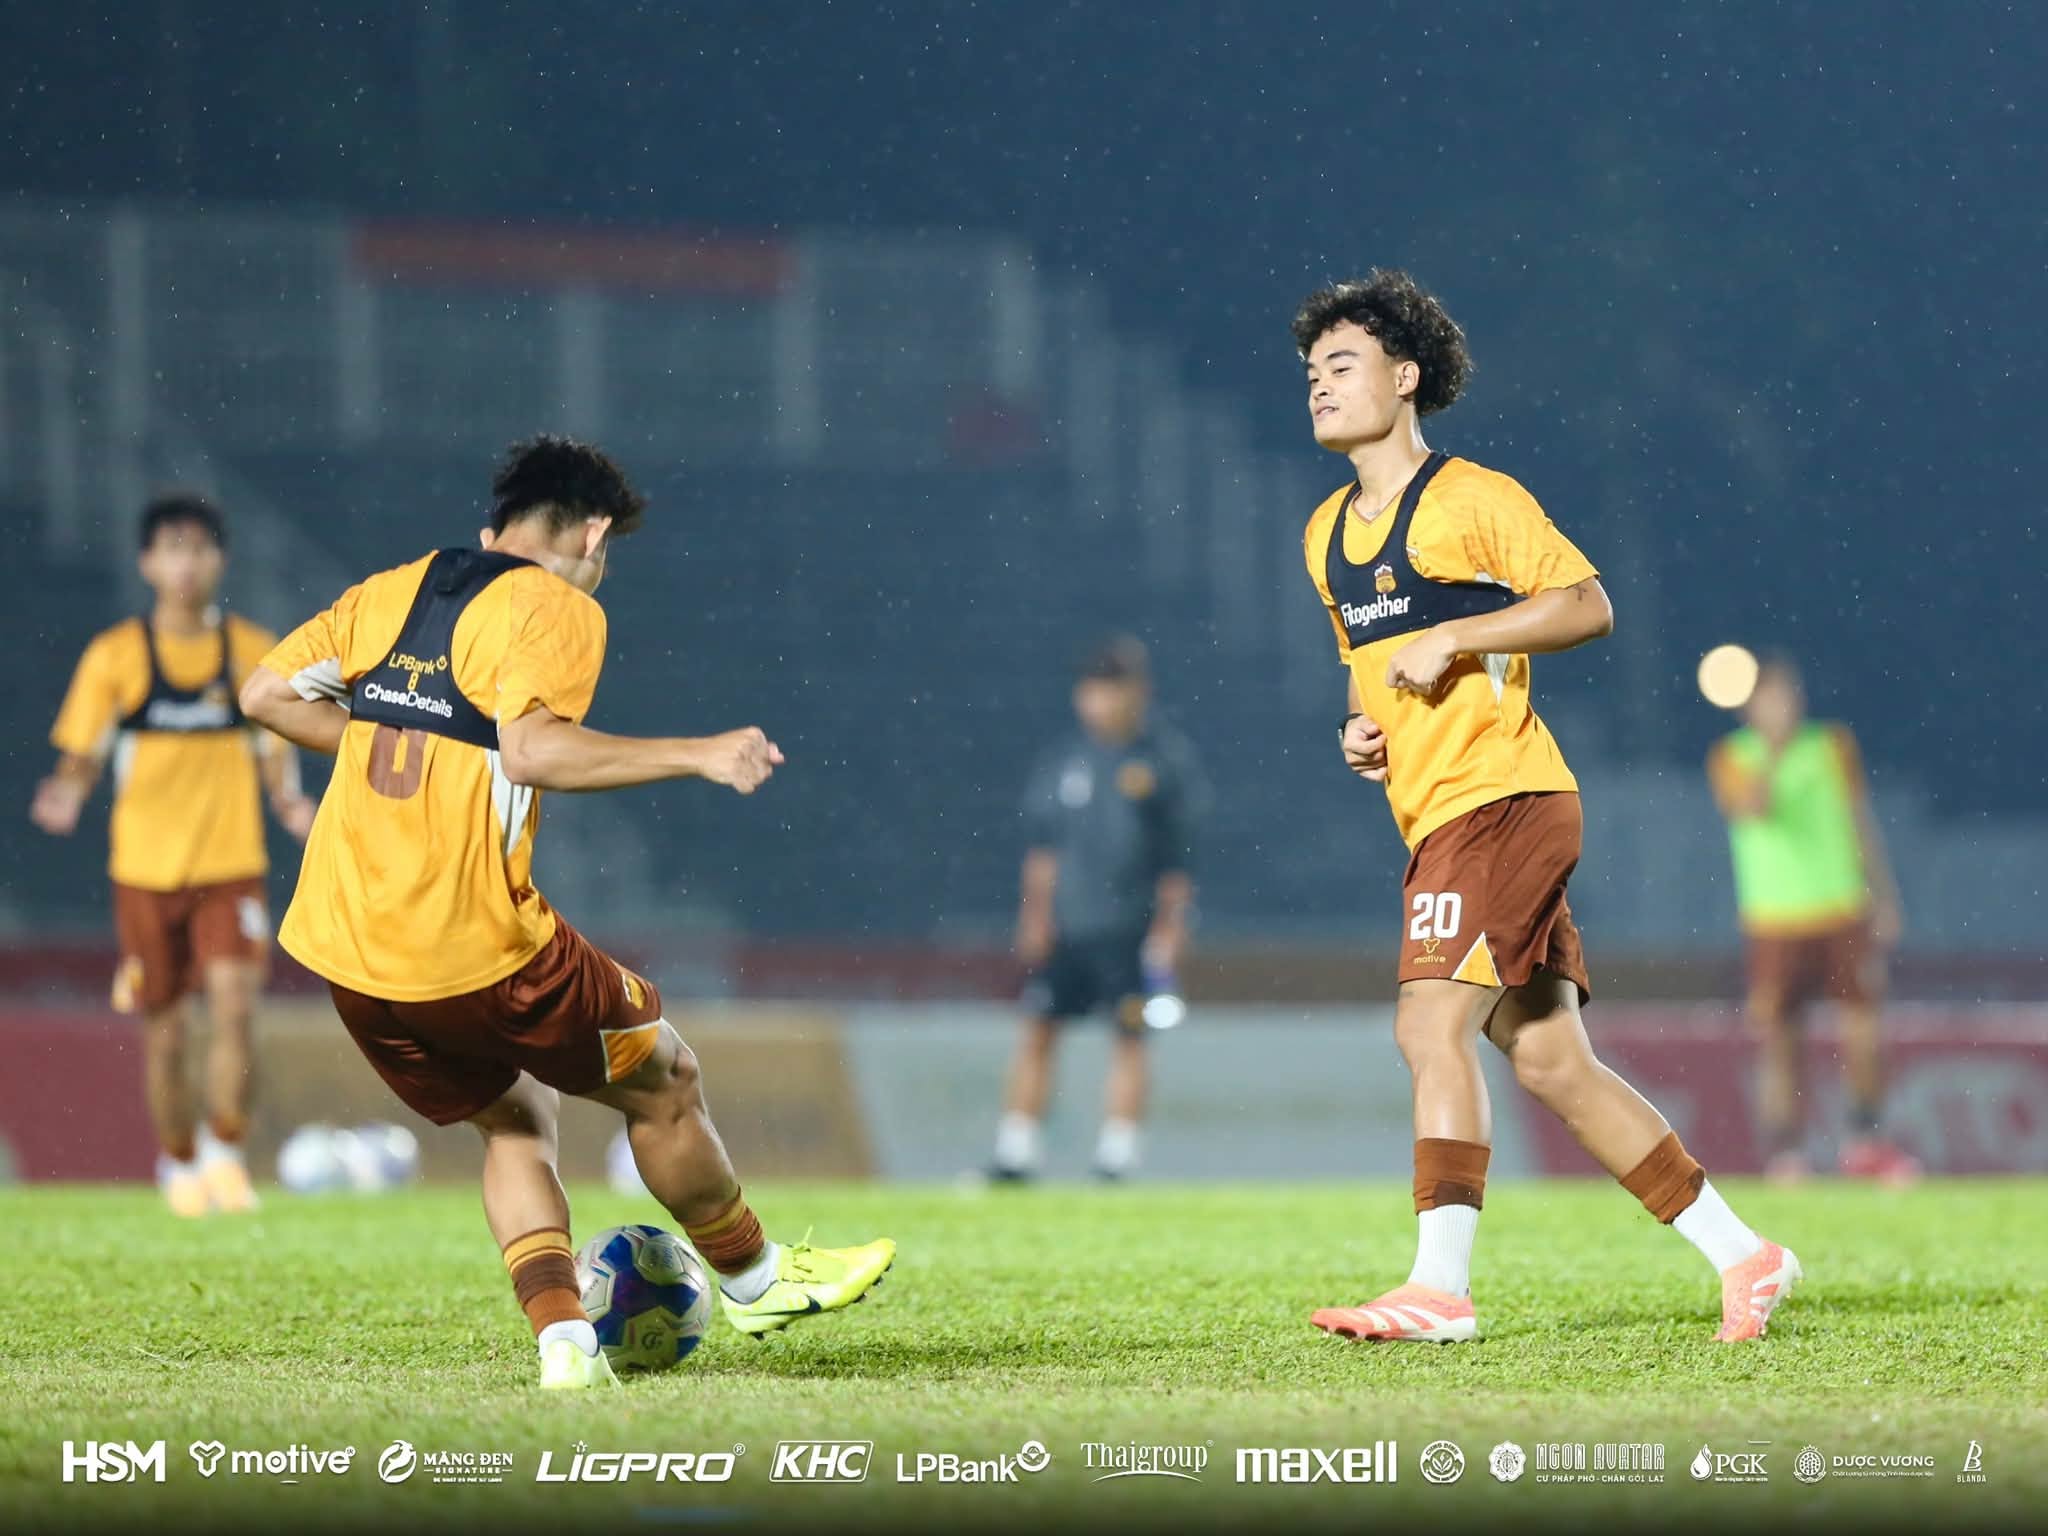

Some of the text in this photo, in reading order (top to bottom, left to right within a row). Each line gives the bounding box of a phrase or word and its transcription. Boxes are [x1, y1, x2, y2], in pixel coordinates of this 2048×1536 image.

[1340, 594, 1411, 628] Fitogether
[388, 652, 436, 676] LPBank
[407, 672, 420, 691] 8
[364, 683, 453, 718] ChaseDetails
[1410, 892, 1463, 940] 20
[1413, 954, 1447, 965] motive
